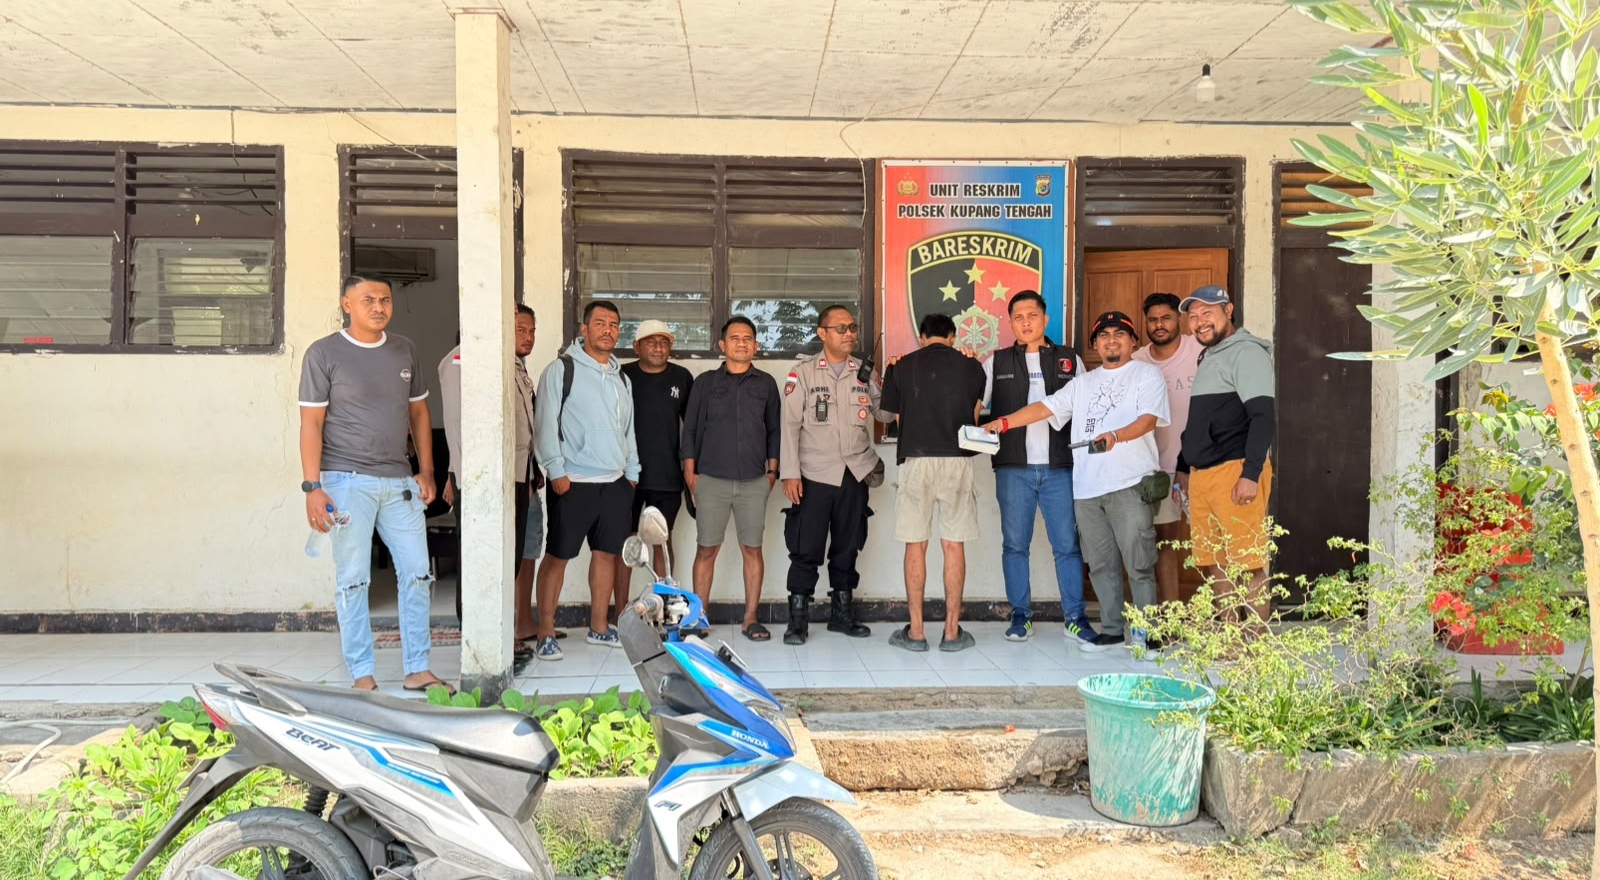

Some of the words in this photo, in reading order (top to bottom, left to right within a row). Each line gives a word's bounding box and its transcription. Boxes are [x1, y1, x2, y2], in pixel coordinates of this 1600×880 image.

[930, 184, 959, 197] UNIT
[964, 184, 1020, 197] RESKRIM
[898, 205, 945, 218] POLSEK
[951, 205, 1000, 218] KUPANG
[1005, 205, 1052, 218] TENGAH
[917, 235, 1033, 265] BARESKRIM
[730, 729, 769, 749] HONDA
